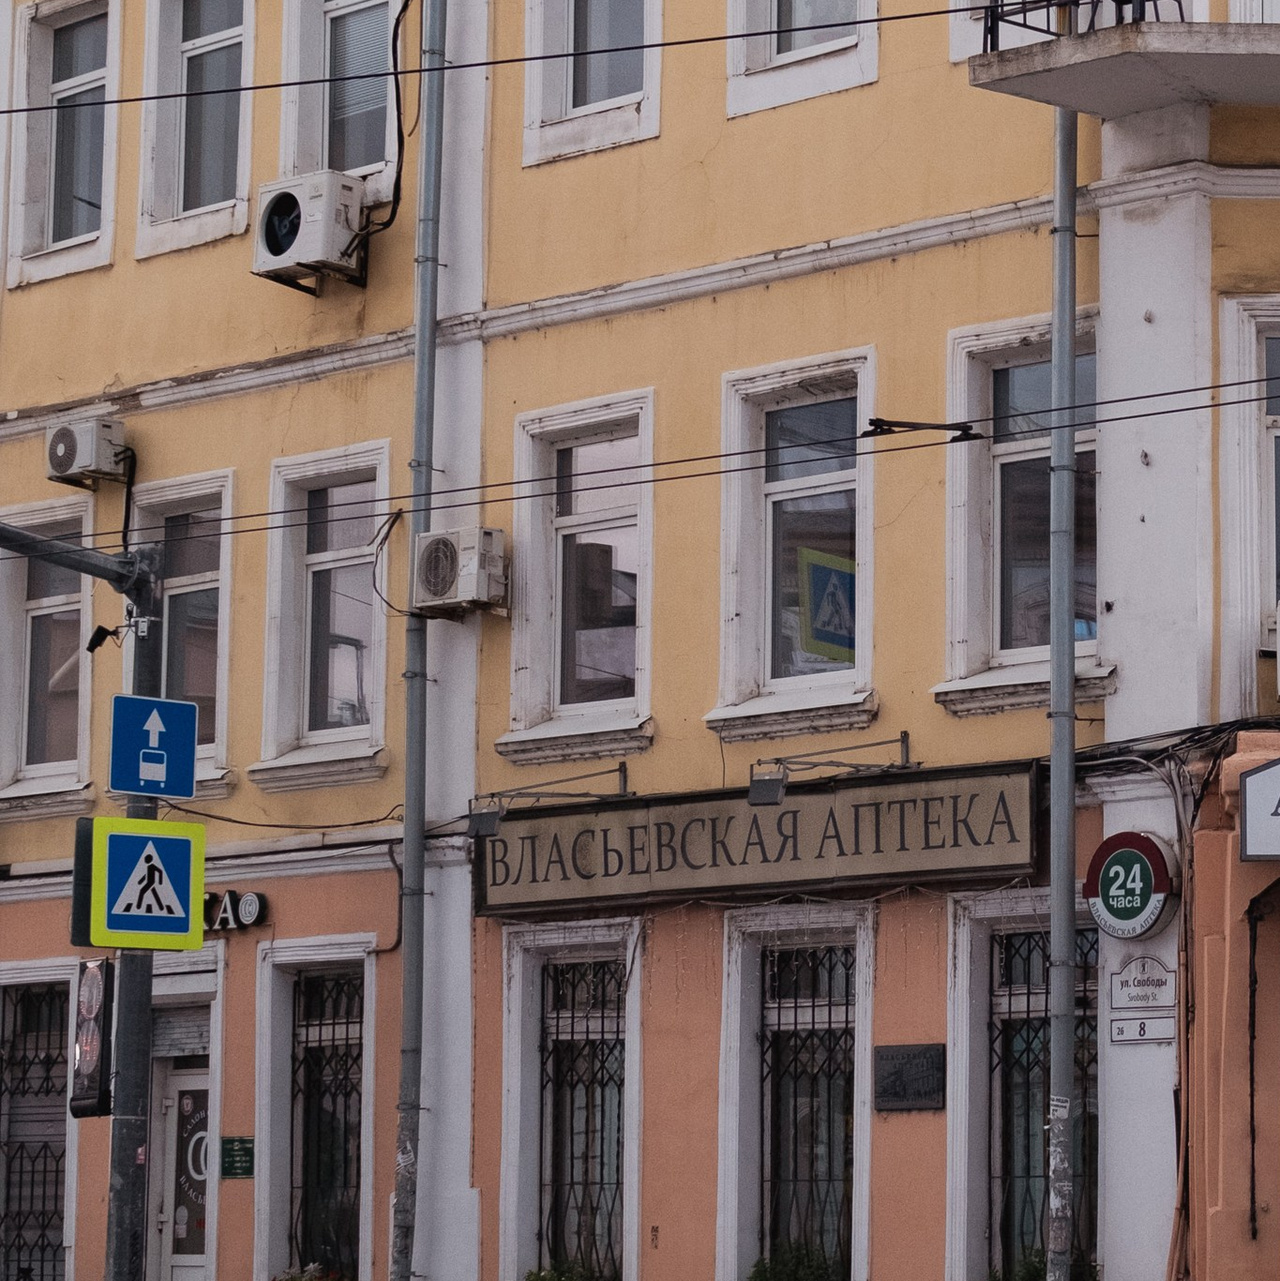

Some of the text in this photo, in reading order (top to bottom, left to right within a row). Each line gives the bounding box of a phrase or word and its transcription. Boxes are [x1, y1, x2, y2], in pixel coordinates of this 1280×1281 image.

[488, 789, 1020, 888] ВЛАСЬЕВСКАЯ АПТЕКА
[1109, 863, 1143, 896] 24
[1109, 896, 1141, 909] часа
[1090, 899, 1163, 937] ВЛАСЬЕВСКАЯ АПТЕКА
[1120, 977, 1167, 990] ул. Свободы
[1127, 992, 1150, 1003] Svobody
[1138, 1021, 1146, 1037] 8
